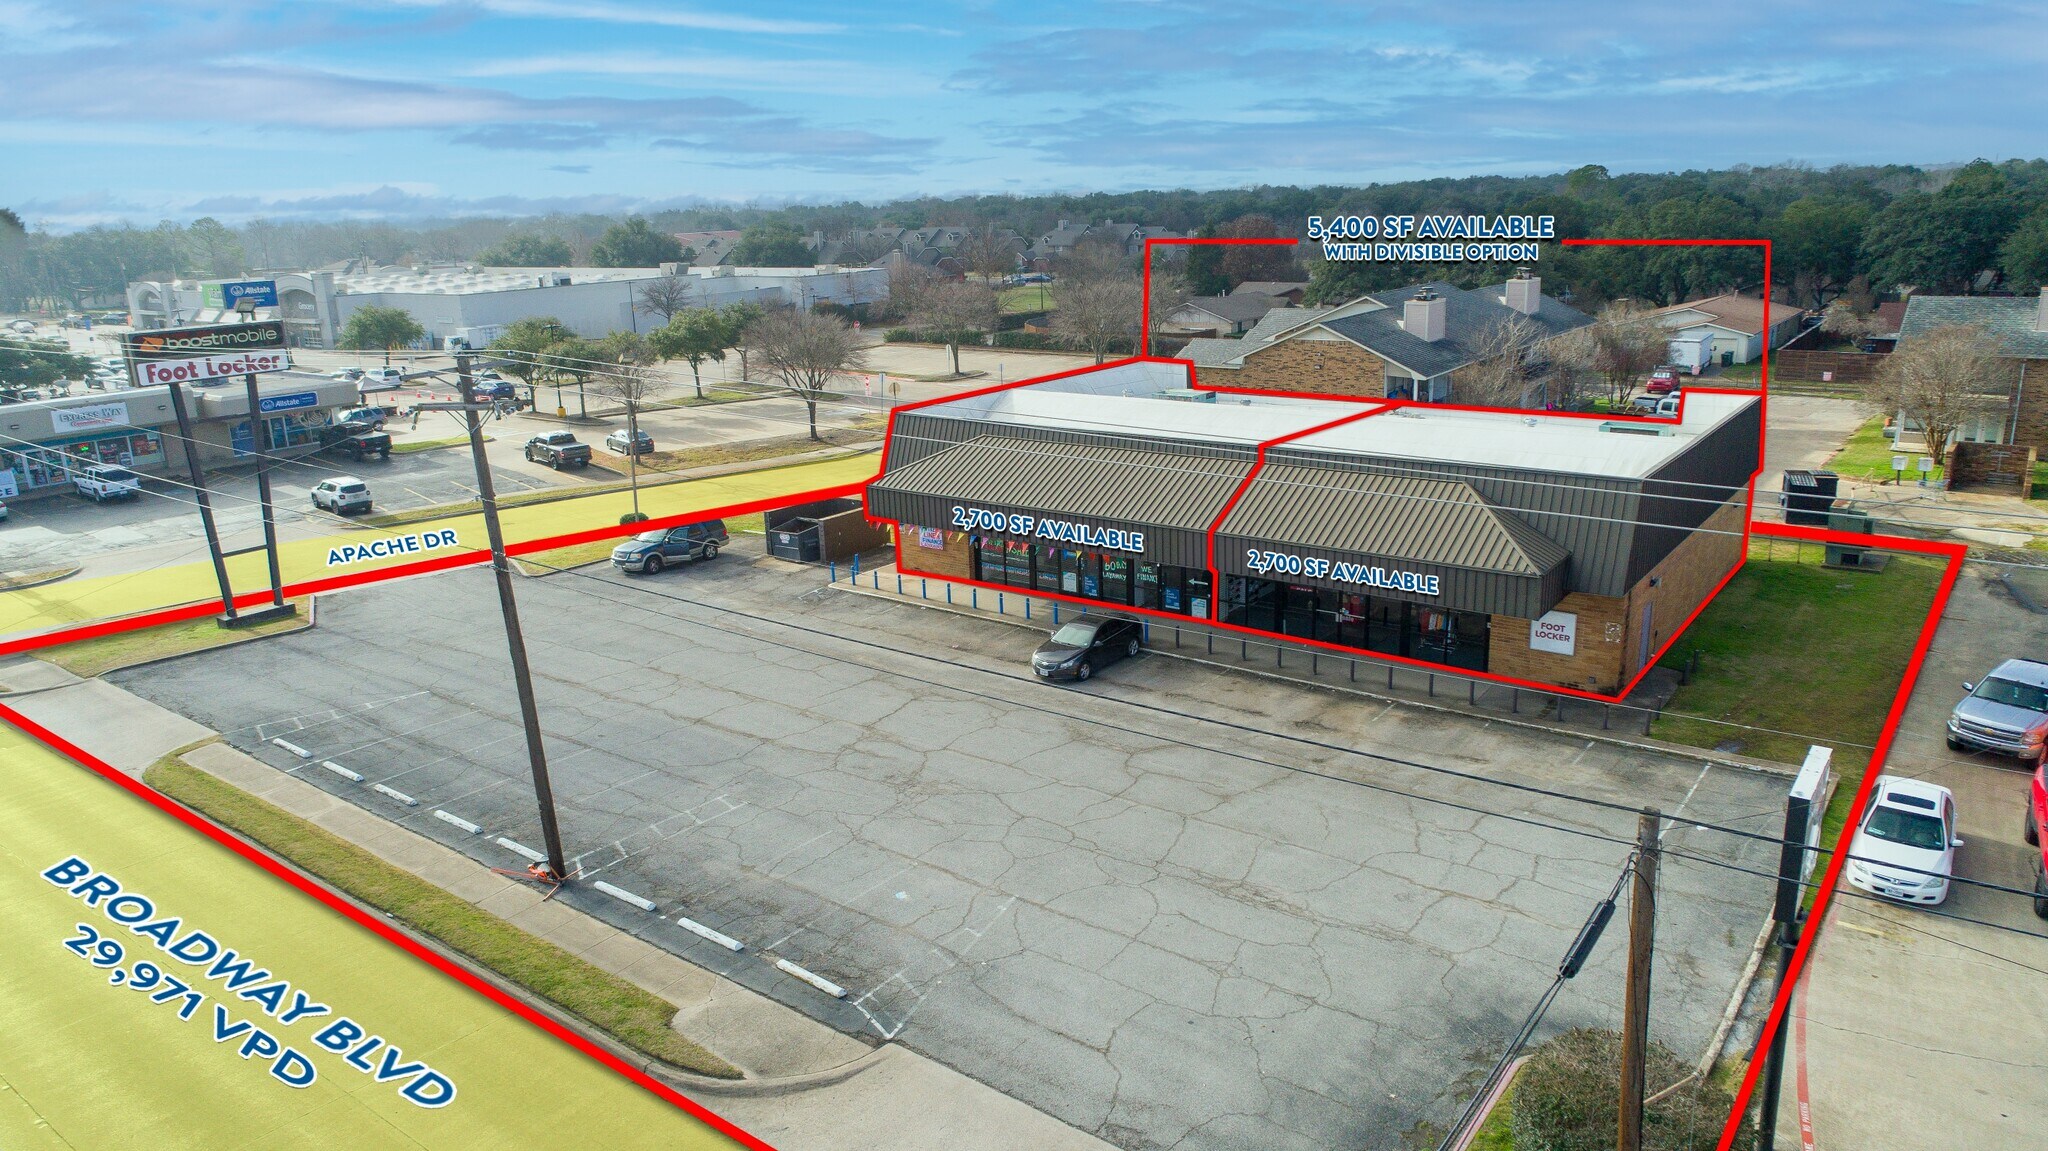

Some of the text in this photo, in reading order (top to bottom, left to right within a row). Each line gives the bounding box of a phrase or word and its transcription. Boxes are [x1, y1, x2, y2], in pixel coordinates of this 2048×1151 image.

[244, 286, 271, 296] Allstate
[145, 354, 281, 384] Foot Locker
[275, 395, 301, 408] Allstate
[1540, 622, 1566, 632] FOOT
[1535, 630, 1571, 642] LOCKER
